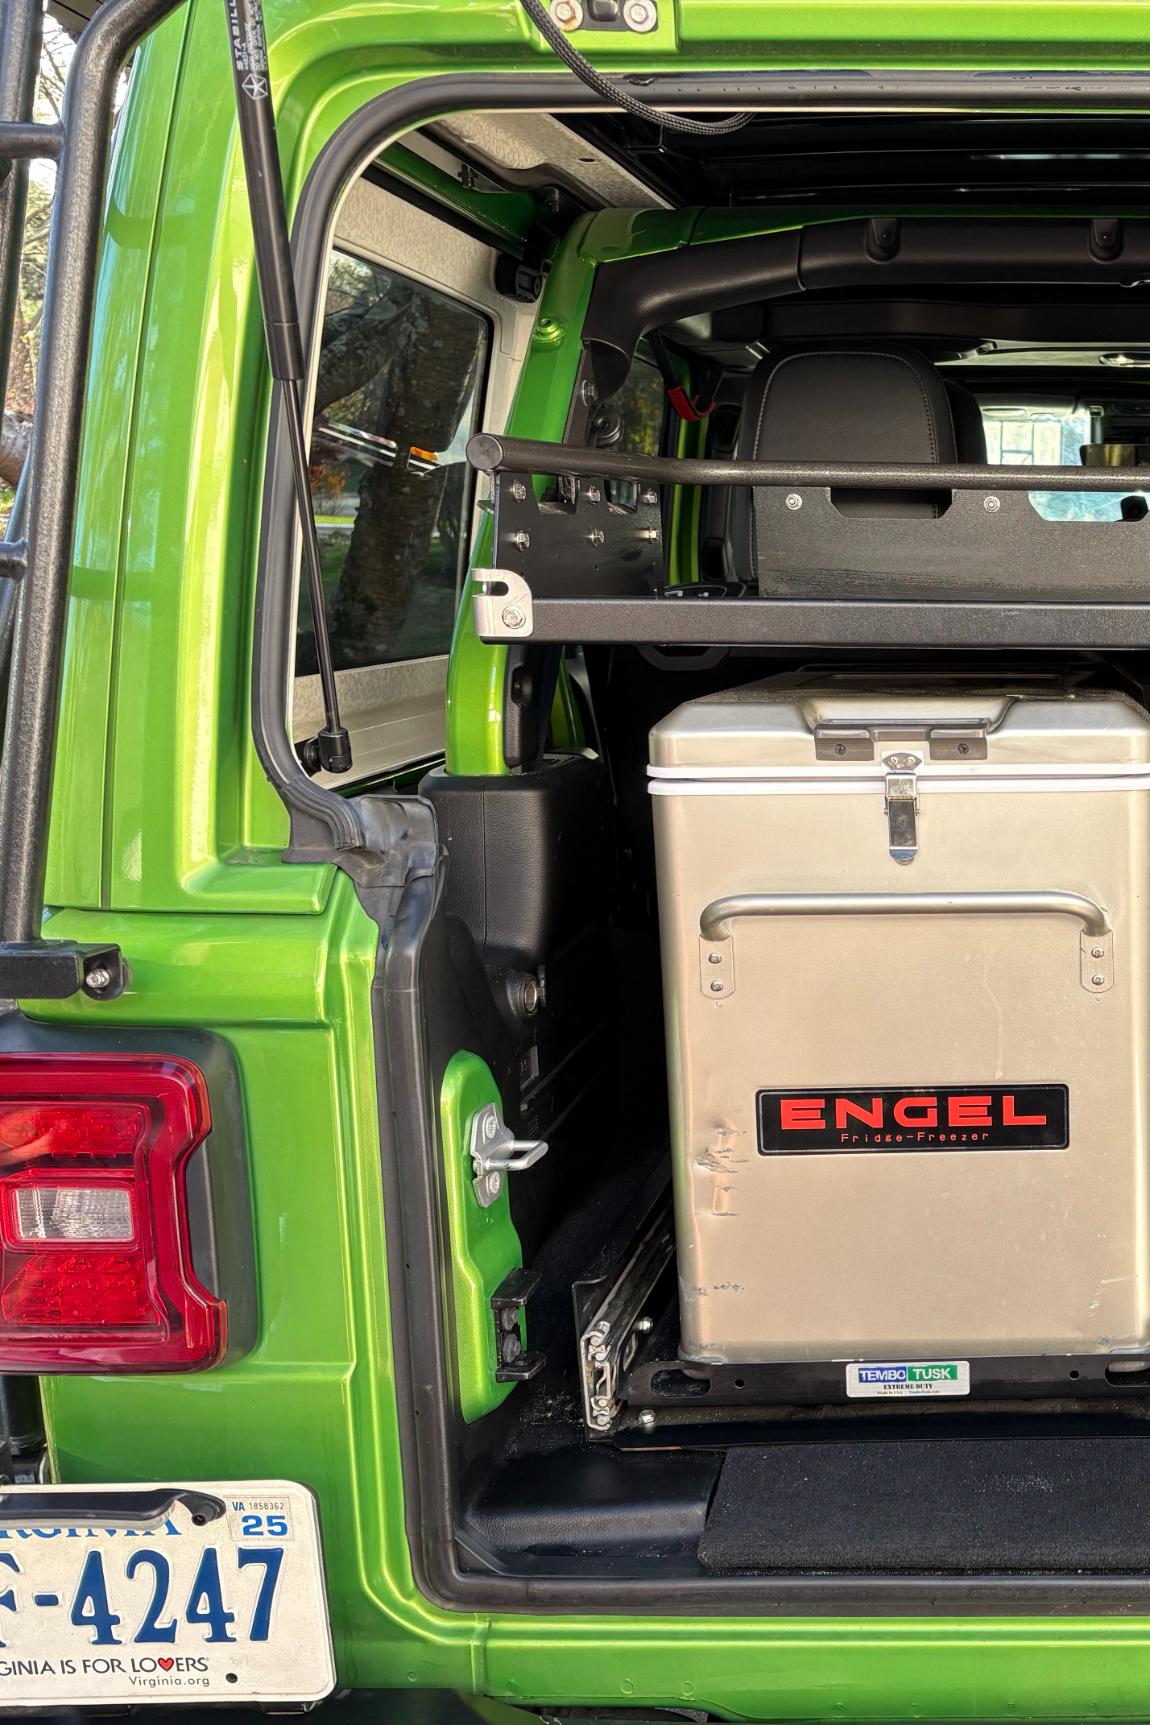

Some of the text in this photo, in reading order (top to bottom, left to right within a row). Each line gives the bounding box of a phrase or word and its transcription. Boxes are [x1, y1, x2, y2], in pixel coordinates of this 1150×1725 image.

[780, 1095, 1047, 1130] ENGEL
[841, 1131, 989, 1144] Fridge-Freezer
[859, 1368, 952, 1382] TEMBO TUSK
[232, 1501, 245, 1511] VA
[241, 1515, 288, 1536] 25
[60, 1659, 77, 1674] IS
[82, 1658, 127, 1674] FOR
[129, 1675, 210, 1688] Virginia.org
